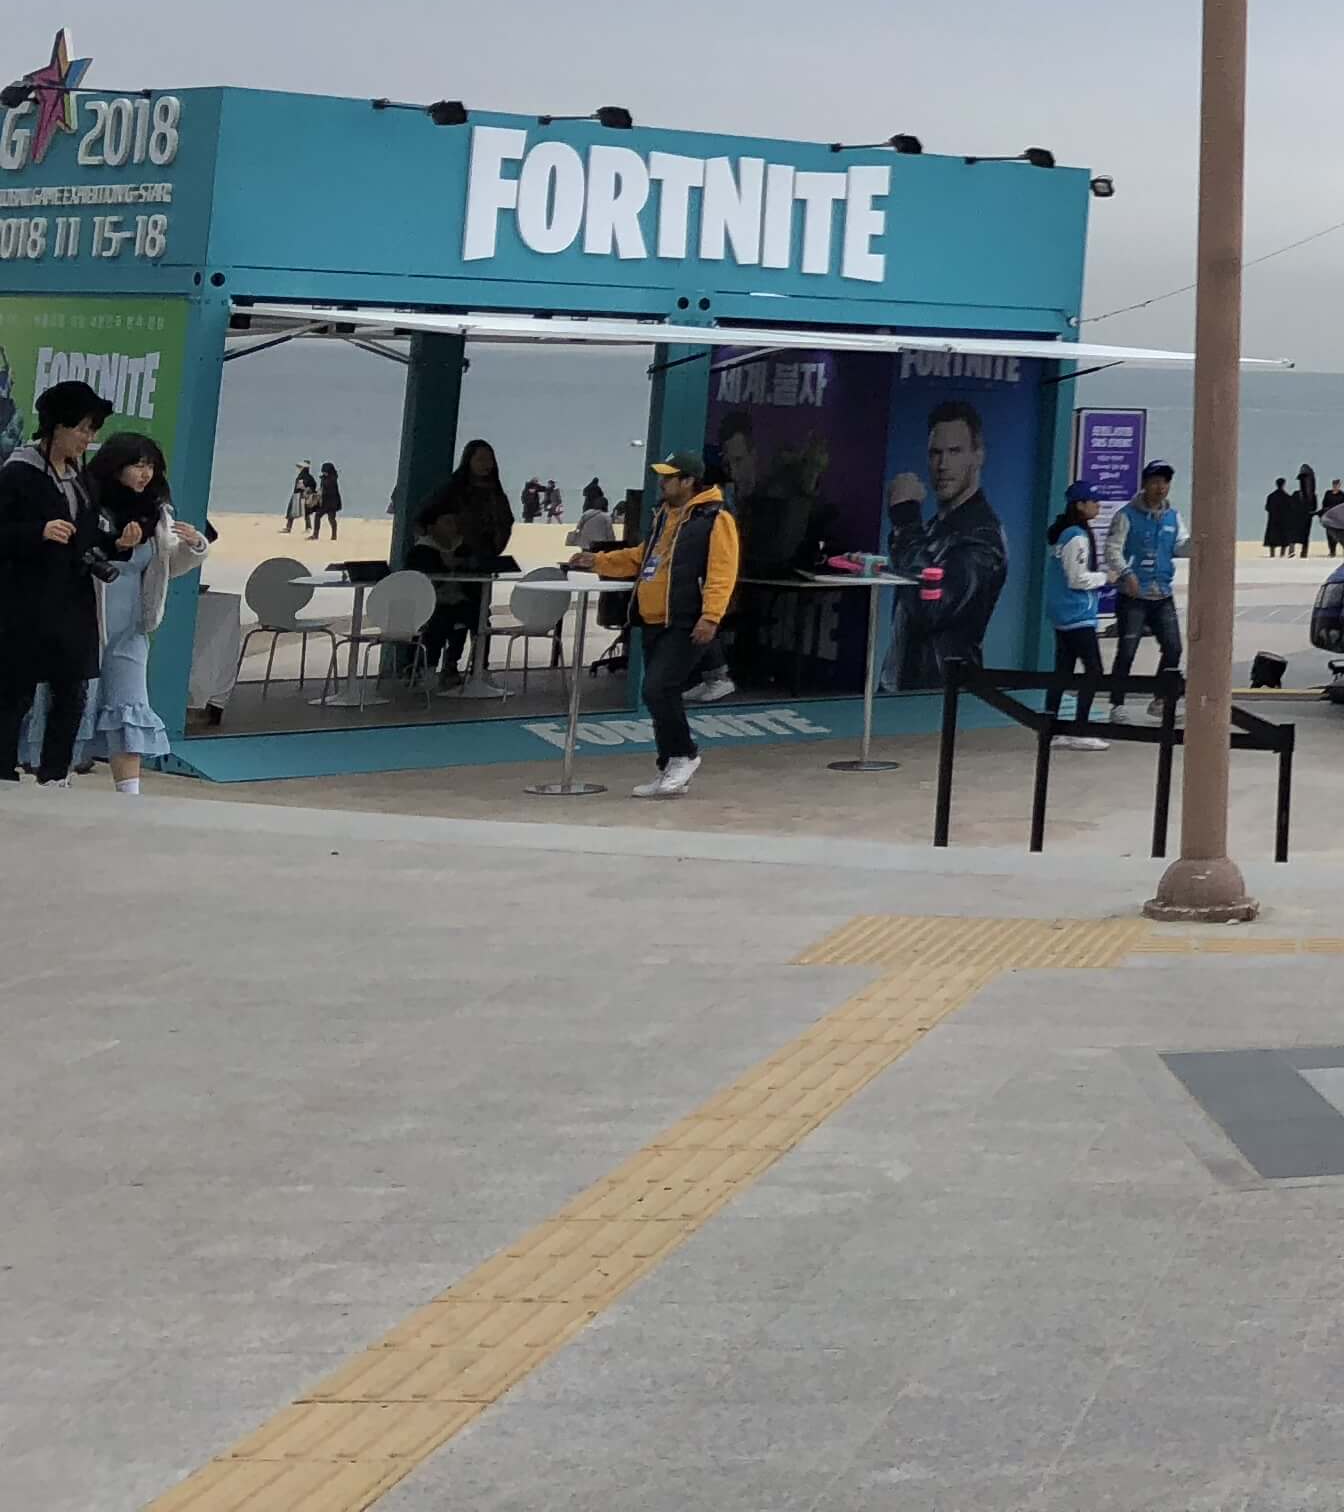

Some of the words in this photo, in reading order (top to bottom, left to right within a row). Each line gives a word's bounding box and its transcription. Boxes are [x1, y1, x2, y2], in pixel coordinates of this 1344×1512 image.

[77, 95, 181, 166] 2018
[0, 216, 48, 259] 018
[53, 216, 81, 258] 11
[91, 213, 168, 258] 15-18
[463, 125, 891, 283] FORTNITE
